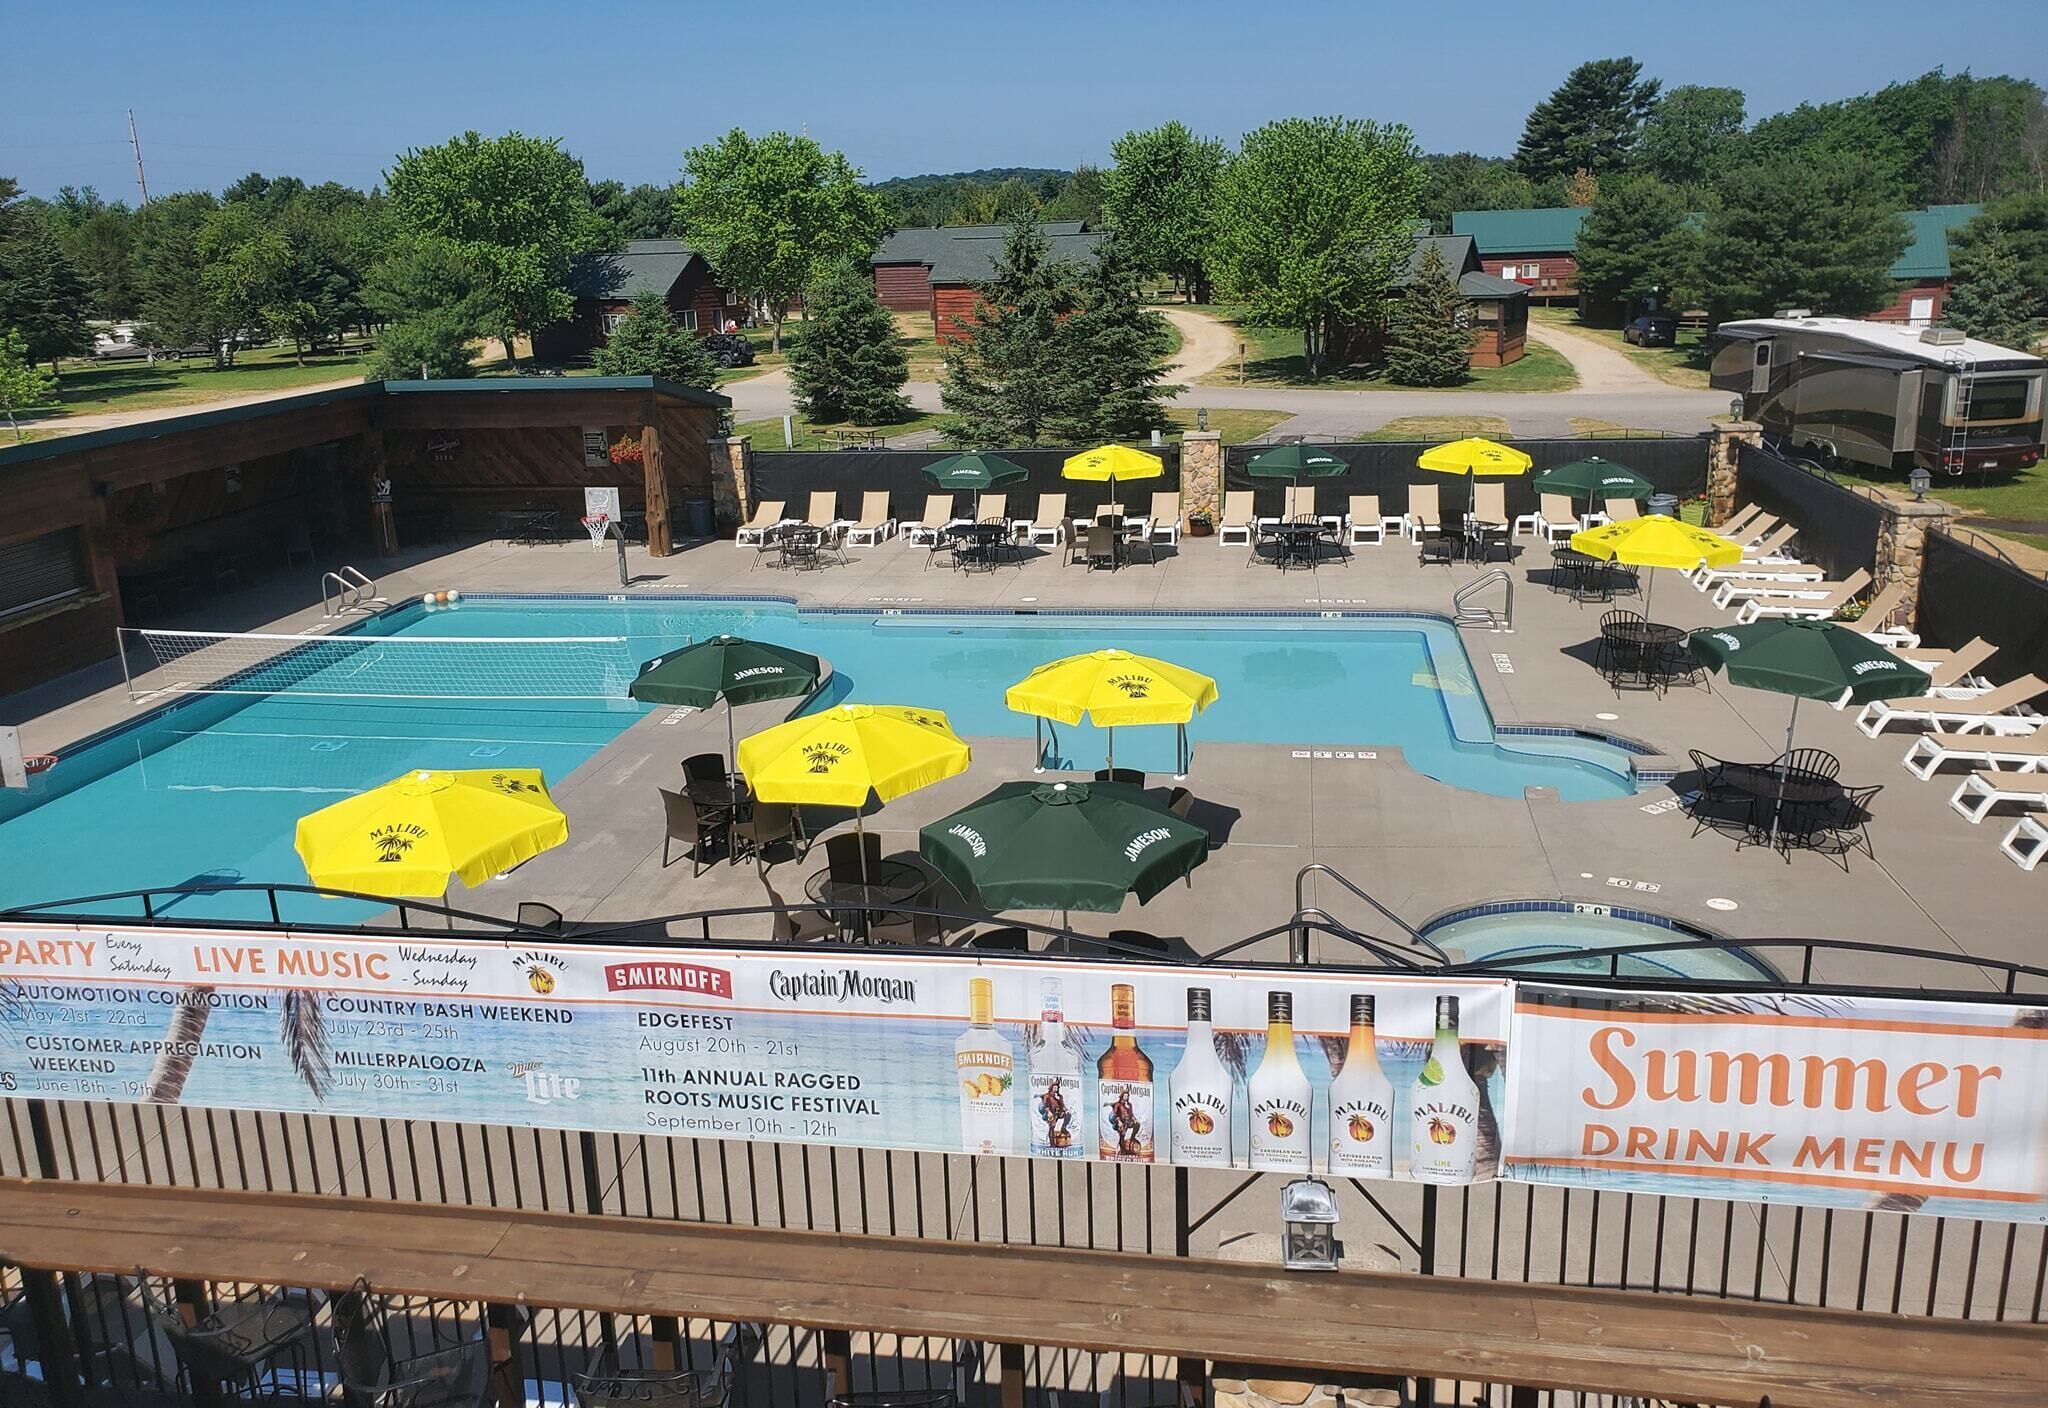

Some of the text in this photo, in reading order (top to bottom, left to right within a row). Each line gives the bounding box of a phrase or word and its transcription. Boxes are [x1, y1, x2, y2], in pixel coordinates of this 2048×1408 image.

[733, 665, 784, 681] JAMESON
[1852, 660, 1898, 676] JAMESON
[1107, 674, 1153, 687] MALIBU
[802, 741, 852, 755] MALIBU
[370, 823, 429, 841] MALIBU
[948, 823, 987, 858] JAMESON
[1124, 827, 1171, 862] JAMESON
[0, 939, 96, 967] PARTY
[105, 934, 143, 955] Every
[194, 946, 391, 980] LIVE MUSIC
[398, 945, 478, 969] Wednesday
[511, 951, 569, 973] MALIBU
[111, 958, 173, 979] Saturday
[412, 969, 471, 992] Sunday
[769, 969, 917, 1004] Captain Morgan
[16, 985, 268, 1009] AUTOMOTION COMMOTION
[20, 1007, 55, 1025] May
[60, 1007, 89, 1022] 21st
[106, 1009, 147, 1025] 22nd
[326, 997, 573, 1024] COUNTRY BASH WEEKEND
[638, 1012, 734, 1031] EDGEFEST
[329, 1022, 360, 1041] July
[366, 1021, 404, 1038] 23rd
[424, 1023, 459, 1040] 25th
[25, 1035, 262, 1060] CUSTOMER APPRECIATION
[639, 1035, 700, 1056] August
[707, 1036, 746, 1054] 20th
[767, 1040, 799, 1057] 21st
[29, 1056, 116, 1074] WEEKEND
[334, 1051, 488, 1073] MILLERPALOOZA
[506, 1061, 544, 1079] Miller
[958, 1052, 1011, 1067] SMIRNOFF
[337, 1072, 366, 1091] July
[373, 1074, 409, 1090] 30th
[429, 1077, 459, 1093] 31st
[641, 1067, 861, 1091] 11th ANNUAL RAGGED
[1030, 1075, 1080, 1090] Captain Morgan
[1581, 1026, 2003, 1119] Summer
[36, 1077, 70, 1092] June
[74, 1078, 105, 1094] 18th
[122, 1080, 154, 1096] 19th
[524, 1070, 581, 1105] Lite
[1101, 1082, 1151, 1098] Captain Morgan
[645, 1090, 880, 1116] ROOTS MUSIC FESTIVAL
[1175, 1092, 1228, 1116] MALIBU
[1254, 1098, 1306, 1121] MALIBU
[1334, 1100, 1388, 1122] MALIBU
[1413, 1102, 1475, 1125] MALIBU
[646, 1111, 741, 1132] September
[747, 1117, 782, 1134] 10th
[803, 1120, 837, 1138] 12th
[1581, 1123, 1985, 1183] DRINK MENU
